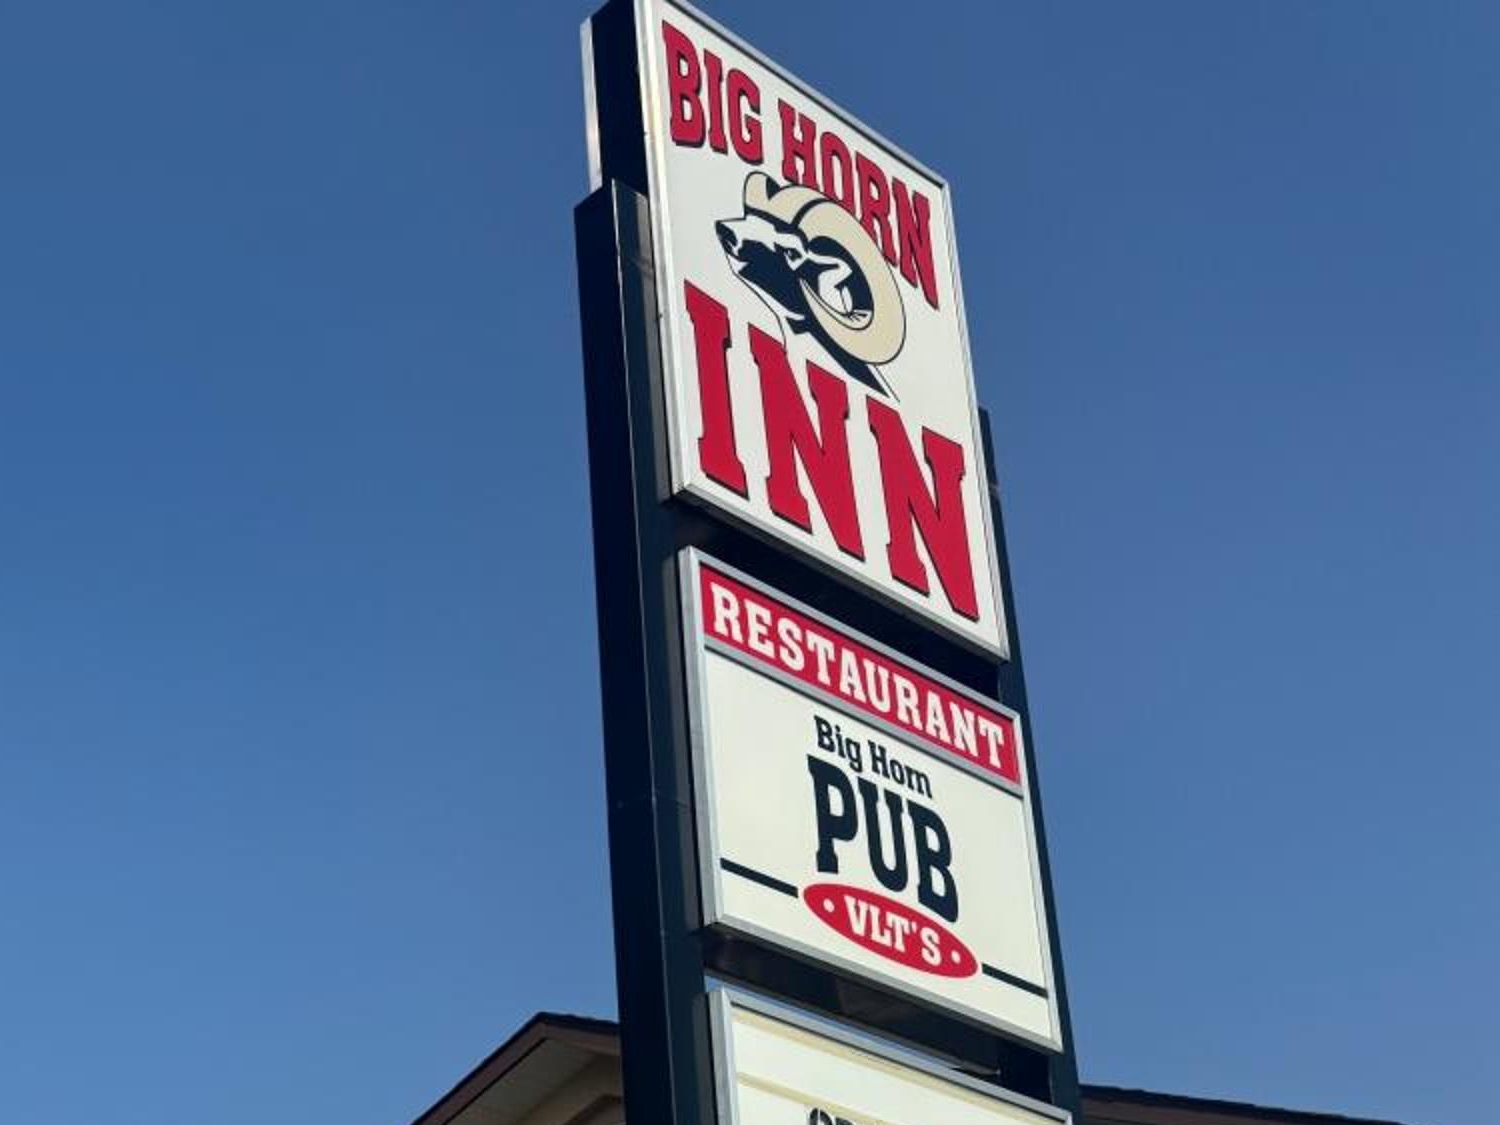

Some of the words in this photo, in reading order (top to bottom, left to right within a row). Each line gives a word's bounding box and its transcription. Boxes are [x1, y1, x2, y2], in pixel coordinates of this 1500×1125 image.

[662, 20, 763, 165] BIG
[778, 97, 939, 310] HORN
[684, 279, 980, 622] INN
[710, 581, 1004, 769] RESTAURANT
[814, 715, 861, 774] Big
[867, 740, 933, 800] Horn
[807, 754, 959, 923] PUB
[844, 894, 943, 968] VLT'S
